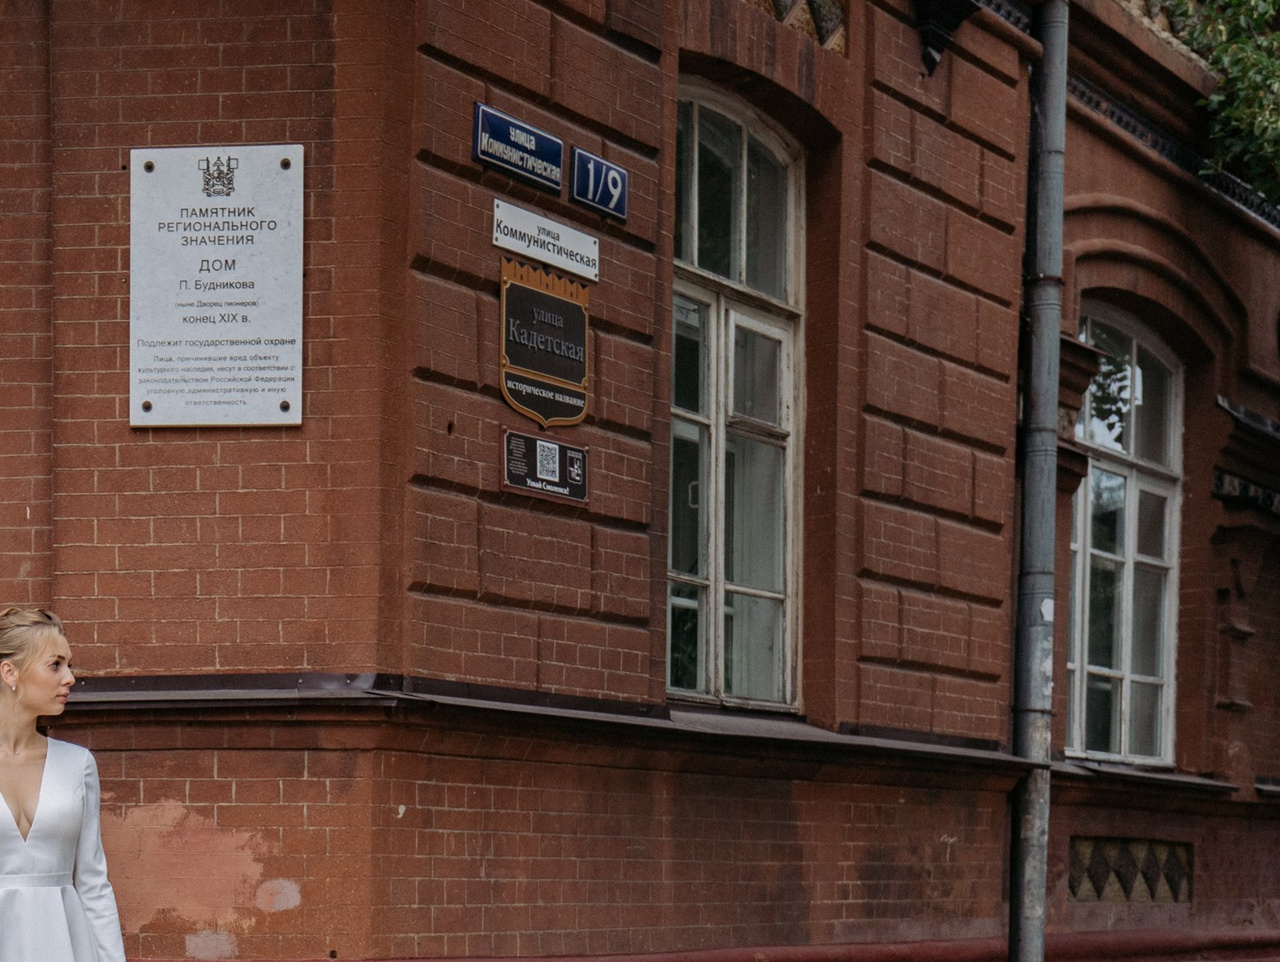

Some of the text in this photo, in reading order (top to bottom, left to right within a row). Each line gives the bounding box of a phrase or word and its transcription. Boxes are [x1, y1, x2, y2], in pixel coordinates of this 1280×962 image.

[481, 132, 560, 182] Коммунистическая
[587, 159, 622, 209] 1/9
[180, 207, 255, 218] ПАМЯТНИК
[158, 220, 277, 232] РЕГИОНАЛЬНОГО
[537, 224, 561, 242] улица
[181, 235, 255, 246] ЗНАЧЕНИЯ
[495, 218, 597, 269] Коммунистическая
[199, 259, 236, 273] ДОМ
[179, 280, 255, 292] П. Будникова
[196, 300, 223, 308] Дворец
[224, 300, 259, 308] пионеров)
[182, 313, 251, 324] конец XIX в.
[533, 308, 564, 327] улица
[137, 338, 297, 348] Подлежит государственной охране
[508, 318, 584, 362] Кадетская
[249, 354, 280, 362] объекту
